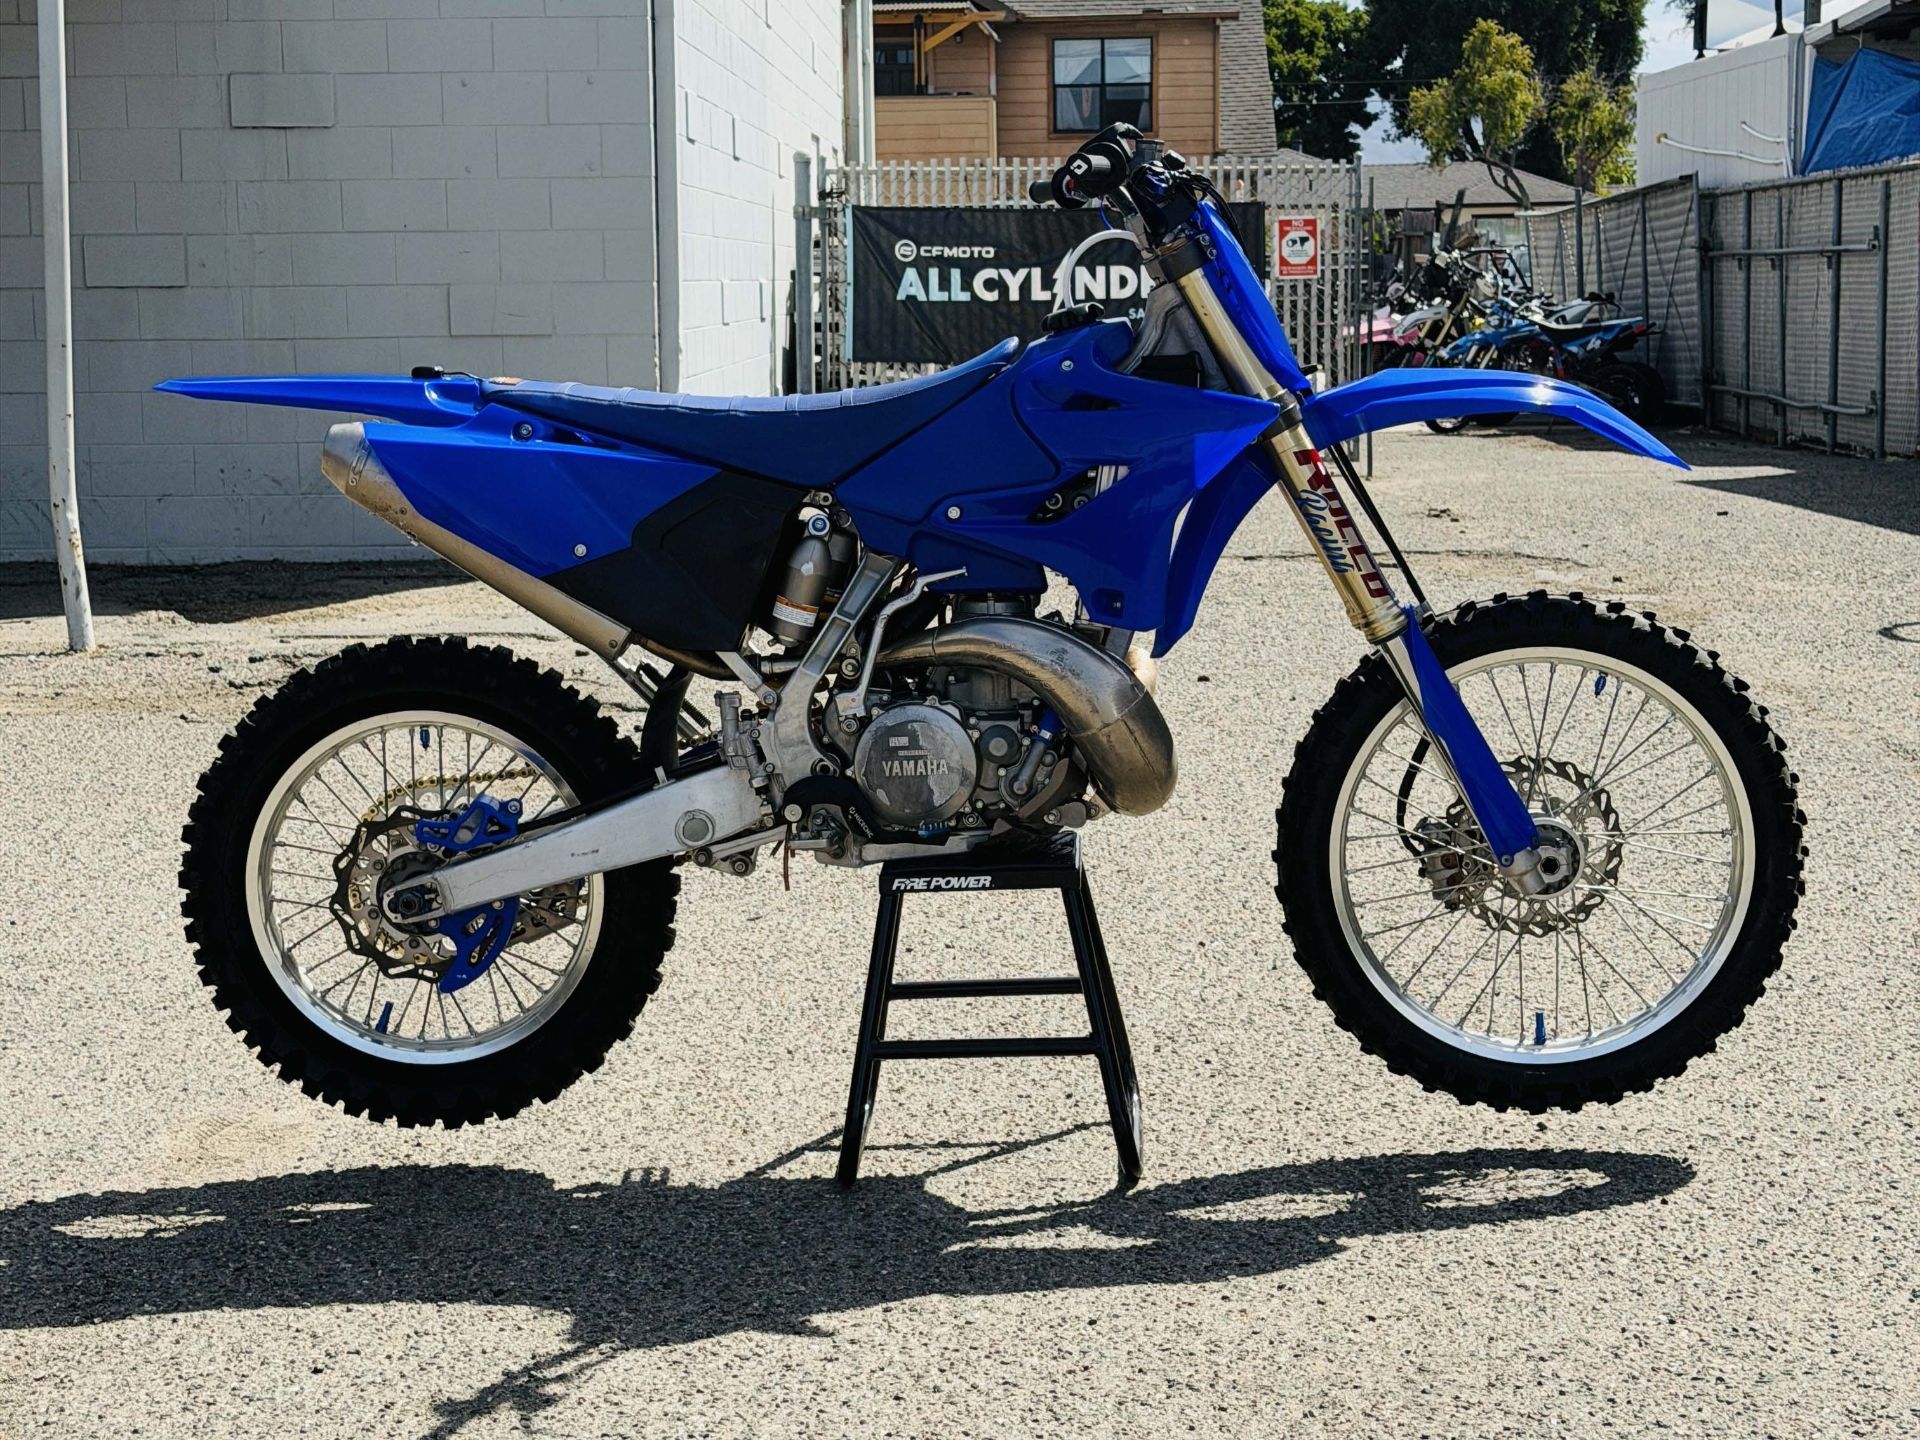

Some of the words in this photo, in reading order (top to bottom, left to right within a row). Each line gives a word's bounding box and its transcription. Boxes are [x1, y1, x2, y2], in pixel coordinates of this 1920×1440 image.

[1292, 219, 1305, 228] NO
[919, 246, 995, 259] CFMOTO
[882, 759, 949, 777] YAMAHA
[892, 877, 931, 891] FIRE
[930, 875, 992, 890] POWER
